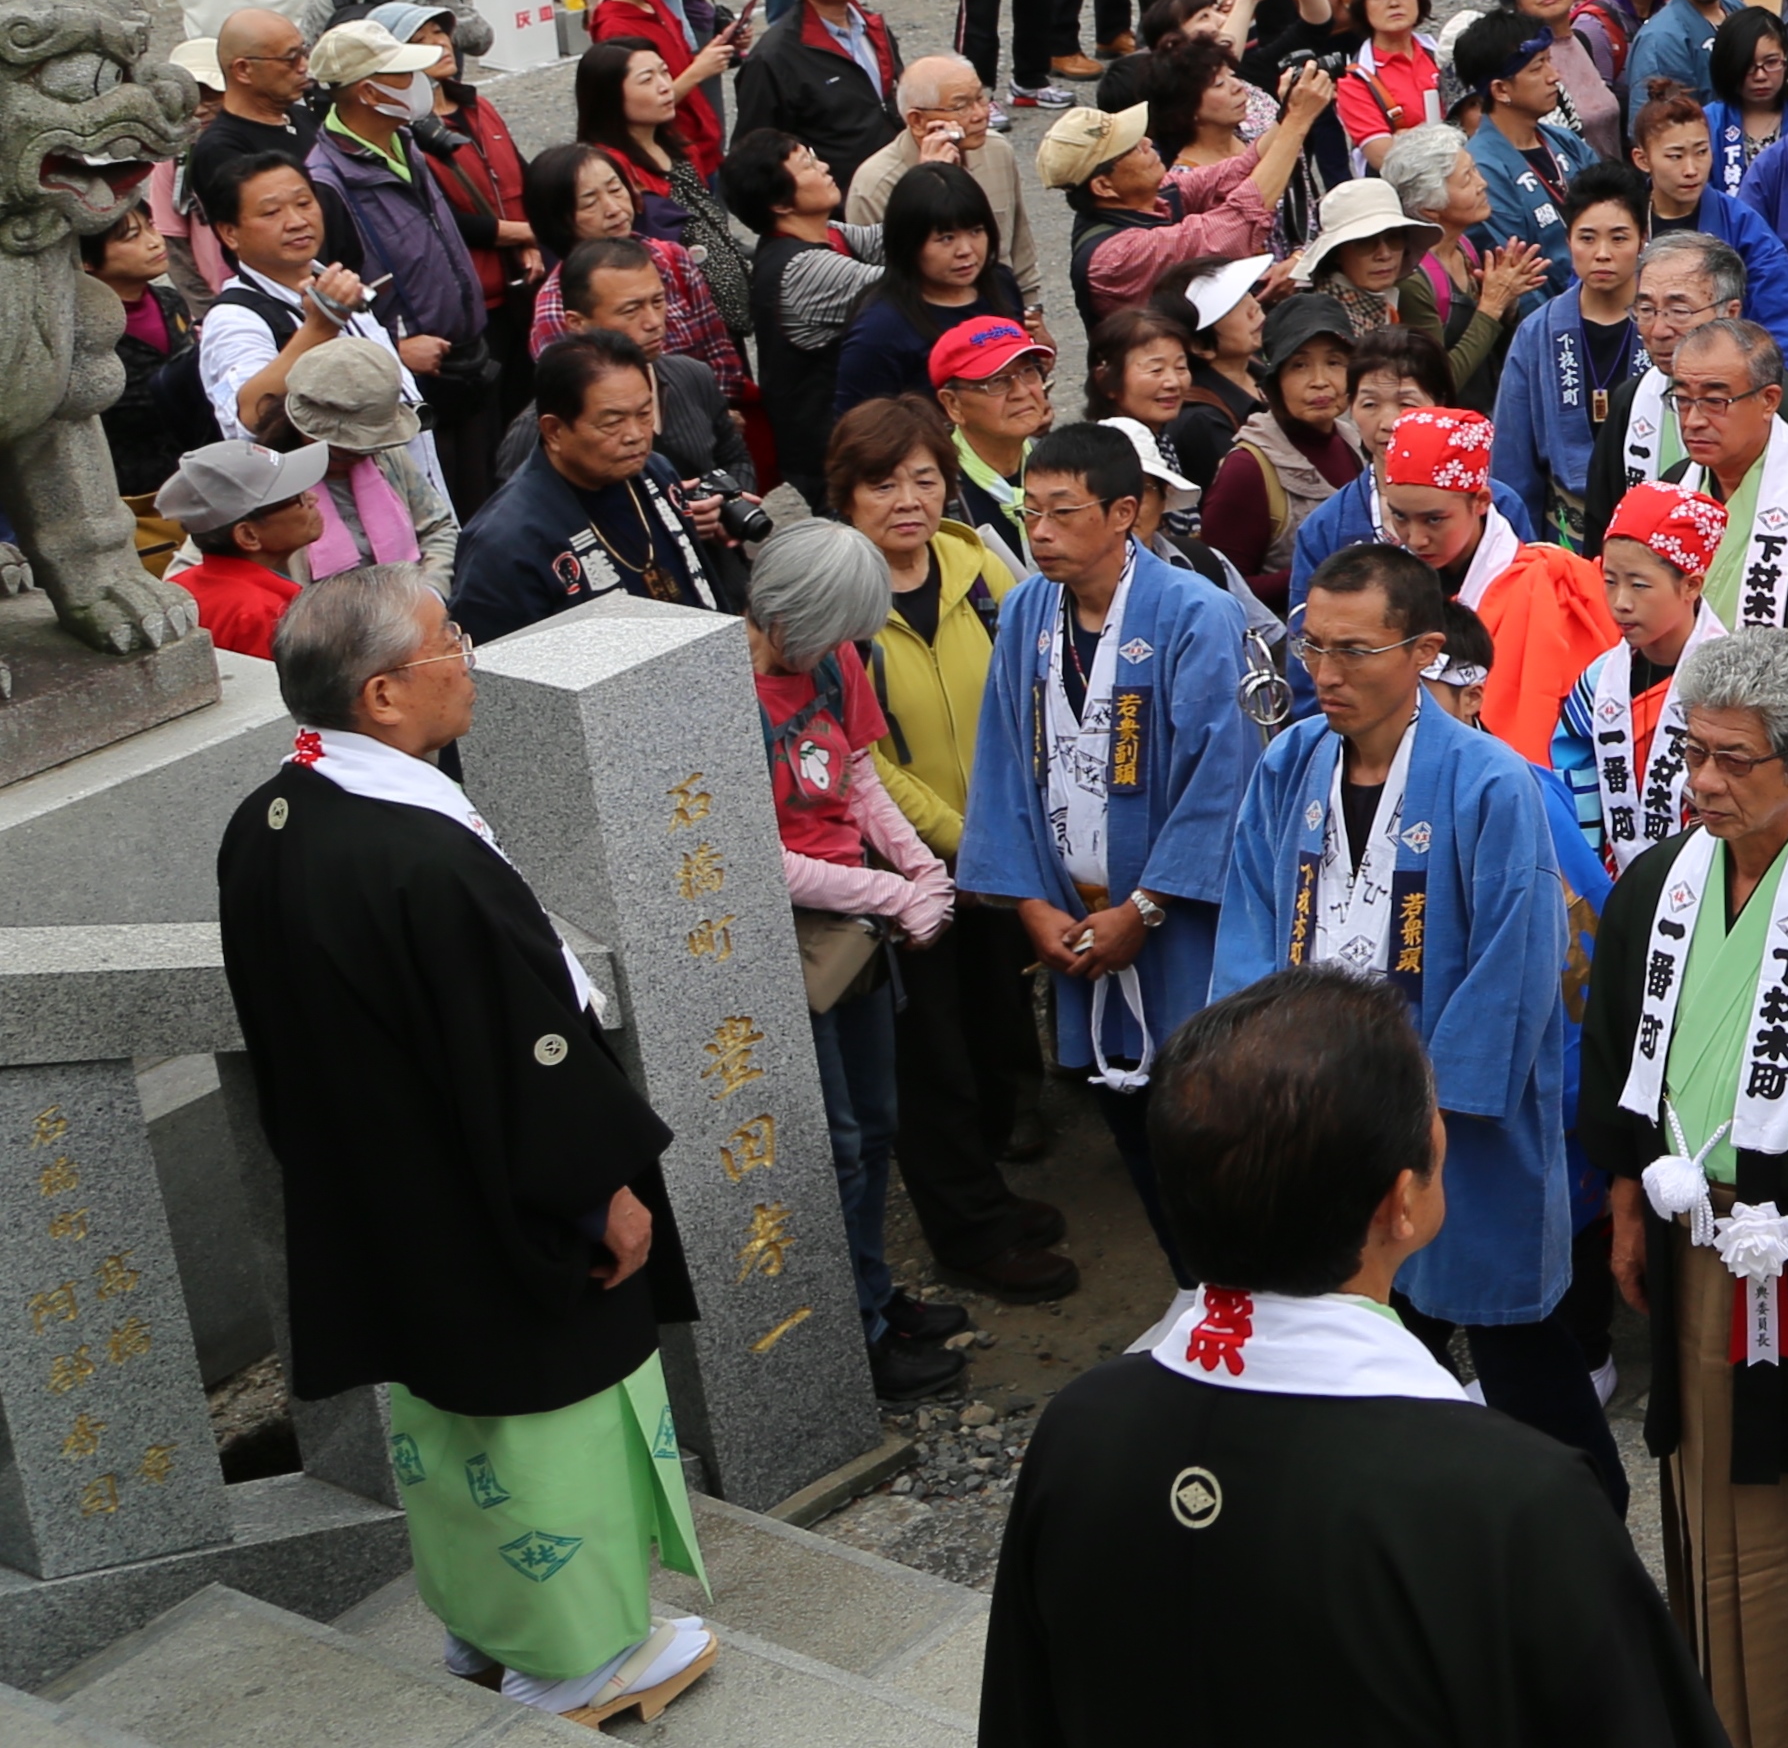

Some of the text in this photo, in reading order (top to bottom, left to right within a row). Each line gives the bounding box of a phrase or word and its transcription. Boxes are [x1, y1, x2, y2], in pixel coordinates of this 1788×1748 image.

[514, 4, 556, 30] 灰皿
[1743, 533, 1788, 629] 下材木
[1597, 729, 1636, 843] 一番町
[1639, 917, 1687, 1060] 一番町
[1754, 1278, 1772, 1348] 典委員長
